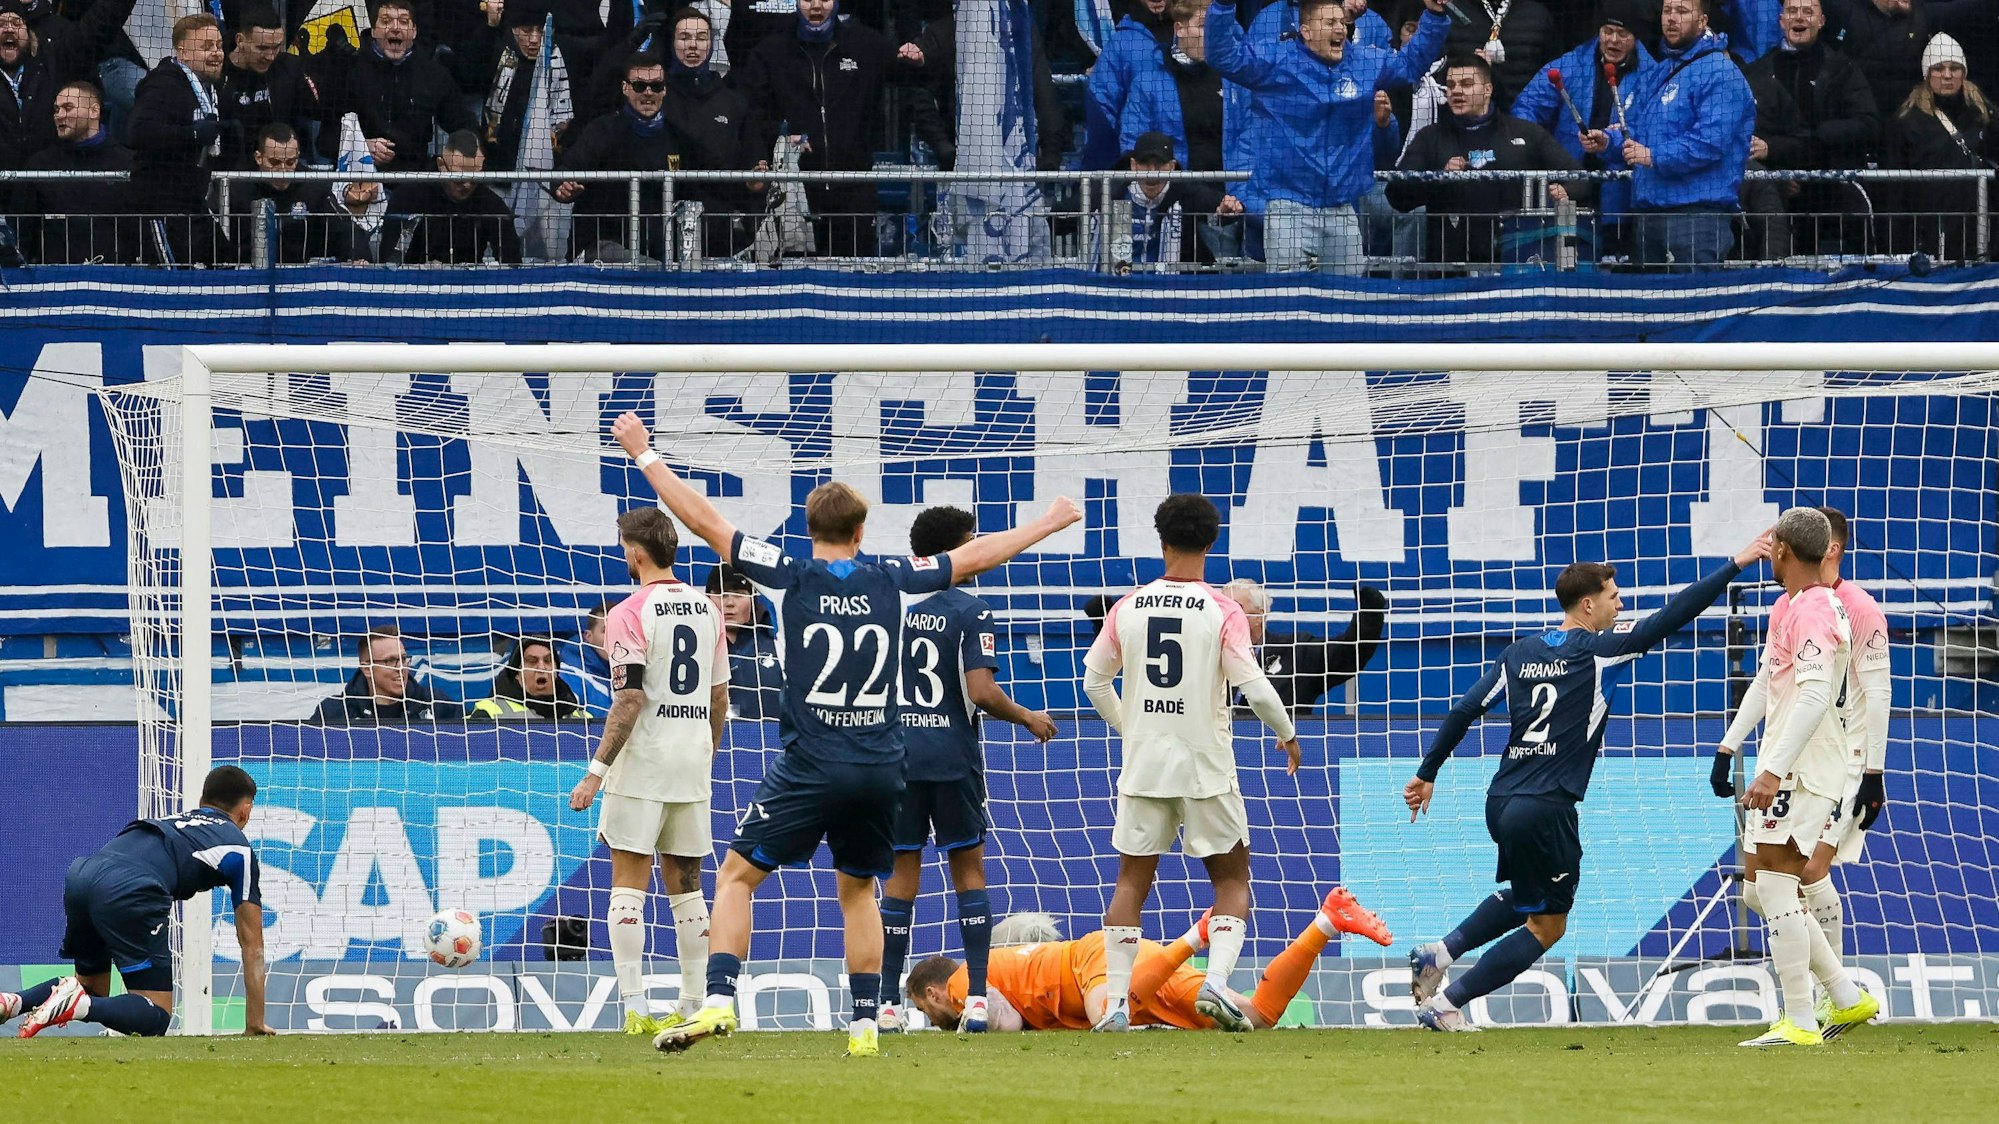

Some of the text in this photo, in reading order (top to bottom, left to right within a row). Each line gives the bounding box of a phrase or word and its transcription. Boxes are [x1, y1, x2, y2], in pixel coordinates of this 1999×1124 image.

[654, 602, 709, 617] BAYER 04
[819, 594, 872, 616] PRASS
[1135, 594, 1205, 612] BAYER 04
[905, 612, 947, 632] NARDO
[669, 624, 700, 696] 8
[1145, 616, 1183, 689] 5
[1866, 652, 1888, 661] NIEDA
[803, 622, 890, 707] 22
[1144, 698, 1185, 715] BADÉ
[1521, 682, 1558, 743] 2
[900, 712, 951, 729] FFENHEIM
[211, 806, 555, 963] SAP
[961, 915, 986, 927] TSG
[884, 925, 909, 936] TSG
[725, 975, 738, 987] TS
[854, 998, 879, 1009] TSG
